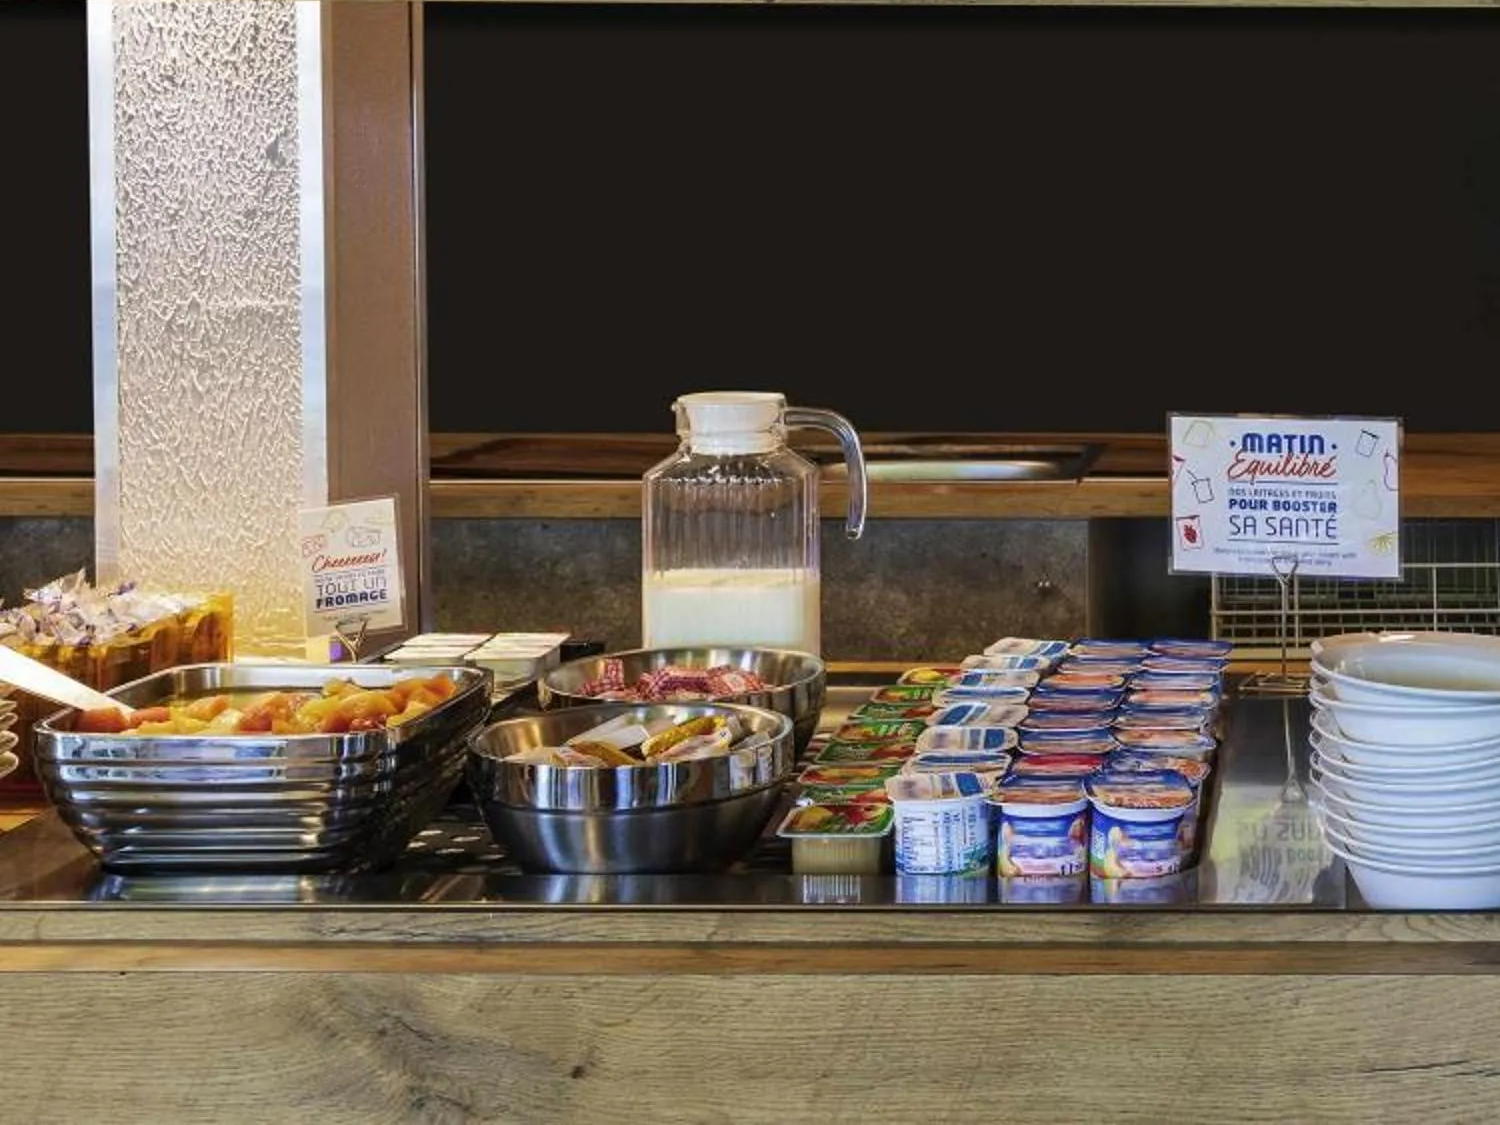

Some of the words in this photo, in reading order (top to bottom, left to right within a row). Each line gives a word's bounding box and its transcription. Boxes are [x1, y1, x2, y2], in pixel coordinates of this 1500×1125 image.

[1242, 432, 1325, 455] MATIN
[1228, 498, 1268, 511] POUR
[1272, 500, 1338, 513] BOOSTER
[1229, 514, 1257, 536] SA
[1265, 514, 1338, 539] SANTÉ
[316, 578, 358, 597] TOUT
[363, 576, 387, 590] UN
[316, 589, 388, 610] FROMAGE
